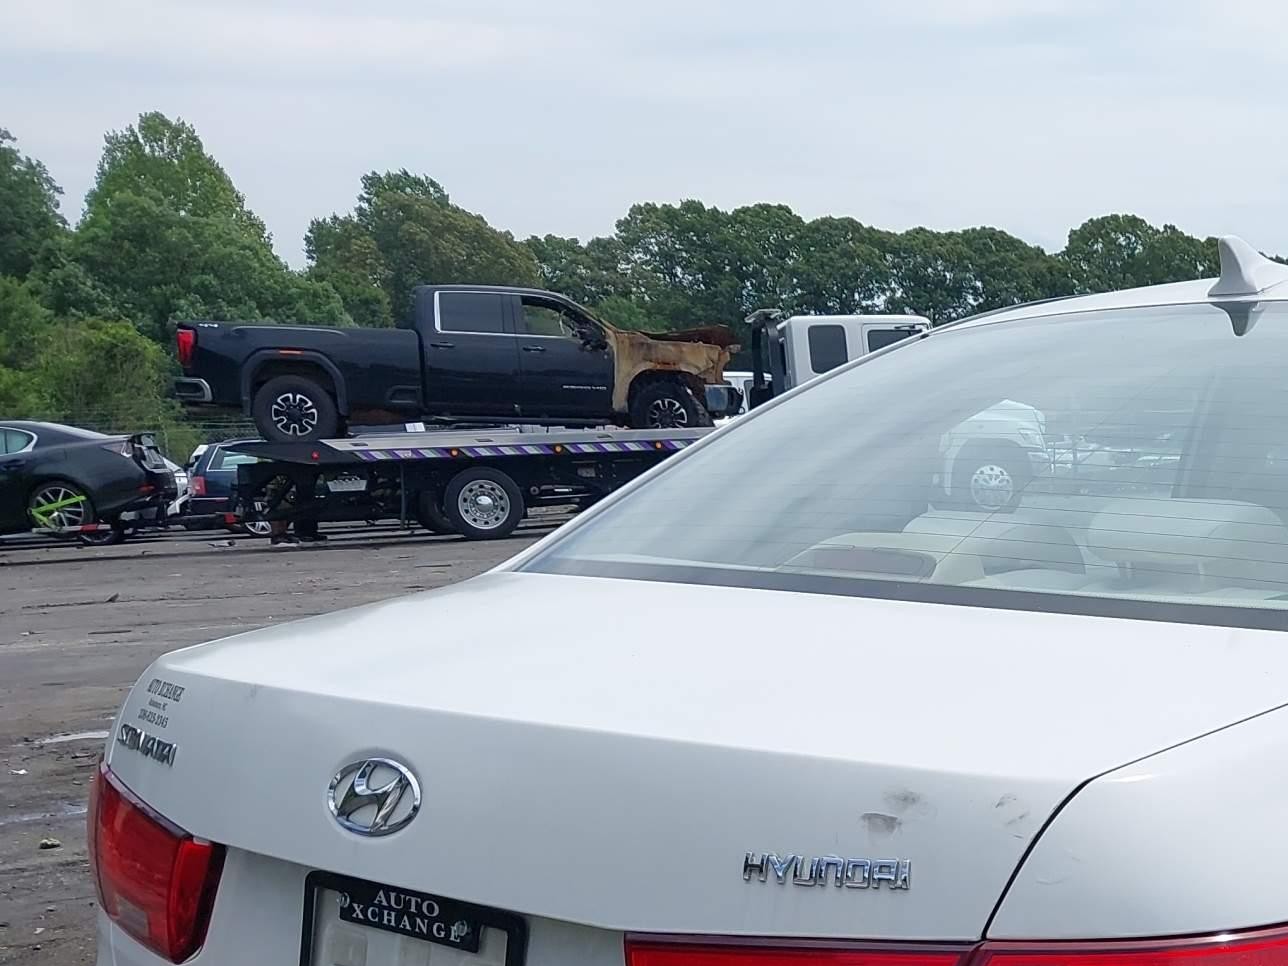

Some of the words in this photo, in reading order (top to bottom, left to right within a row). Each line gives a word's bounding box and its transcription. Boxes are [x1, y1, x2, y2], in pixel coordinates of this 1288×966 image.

[743, 851, 912, 891] HYUNDAI
[352, 903, 461, 943] XCHANGE
[374, 889, 440, 917] AUTO
